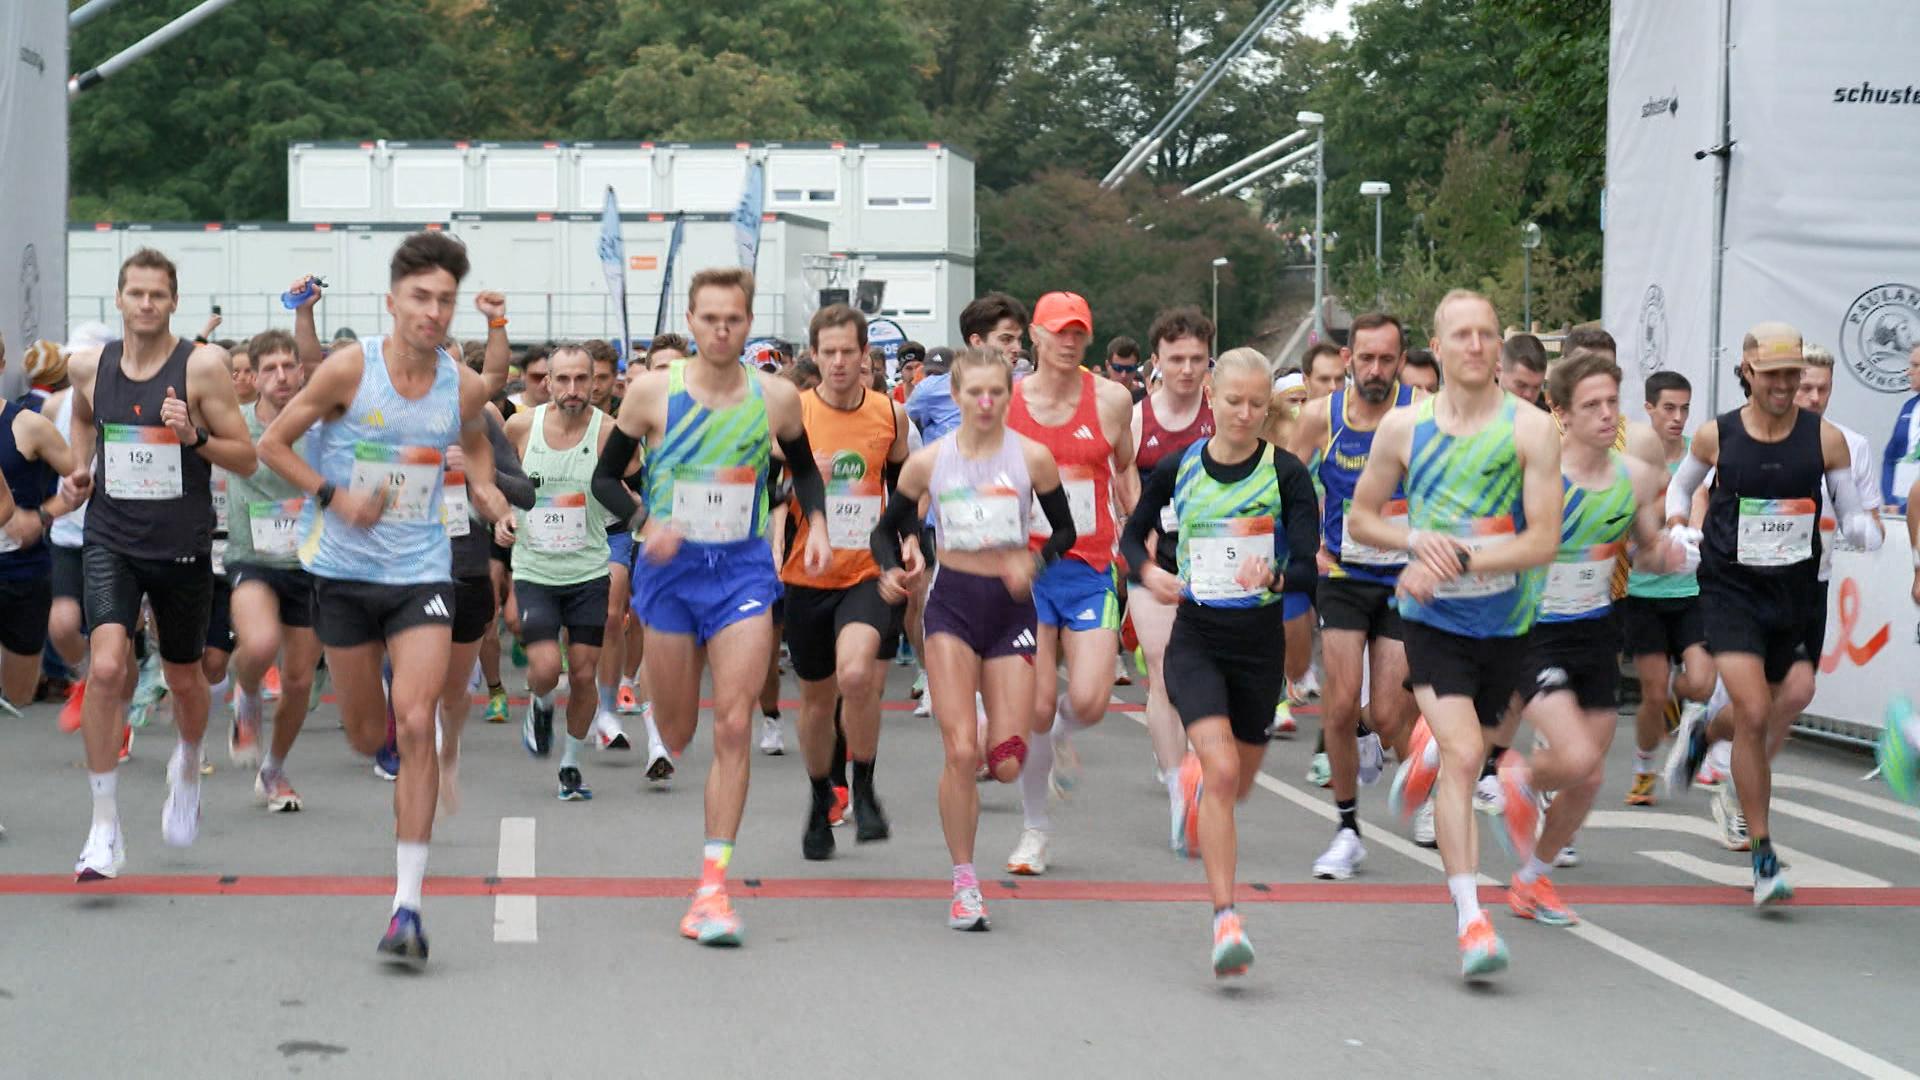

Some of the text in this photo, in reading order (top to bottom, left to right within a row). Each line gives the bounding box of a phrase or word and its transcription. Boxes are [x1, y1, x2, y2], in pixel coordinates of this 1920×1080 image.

[130, 451, 153, 464] 152
[544, 513, 565, 524] 281
[1762, 521, 1794, 533] 1287
[1226, 547, 1236, 560] 5
